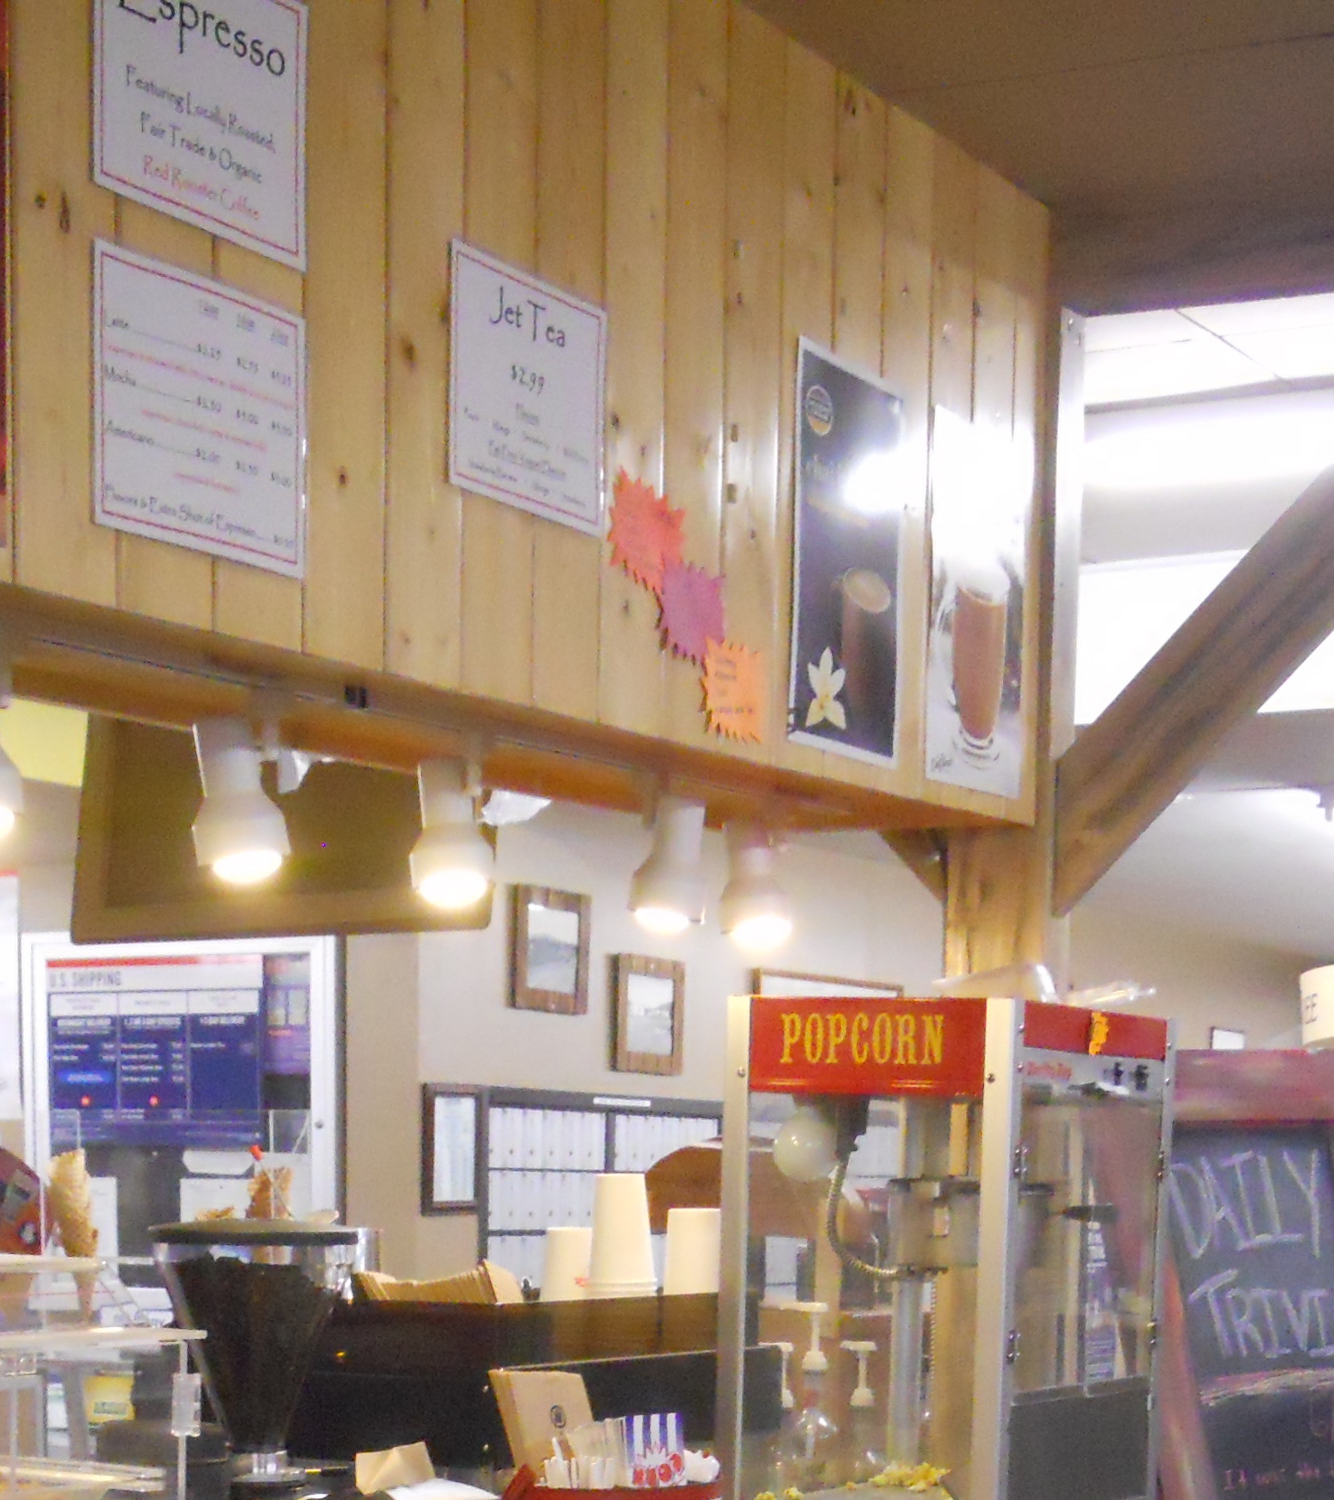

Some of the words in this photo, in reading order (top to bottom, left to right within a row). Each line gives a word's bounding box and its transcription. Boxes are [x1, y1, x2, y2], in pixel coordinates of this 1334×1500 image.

[489, 285, 522, 328] Jet
[527, 299, 565, 348] Tea
[780, 1012, 945, 1065] POPCORN
[1169, 1150, 1323, 1260] DAILY
